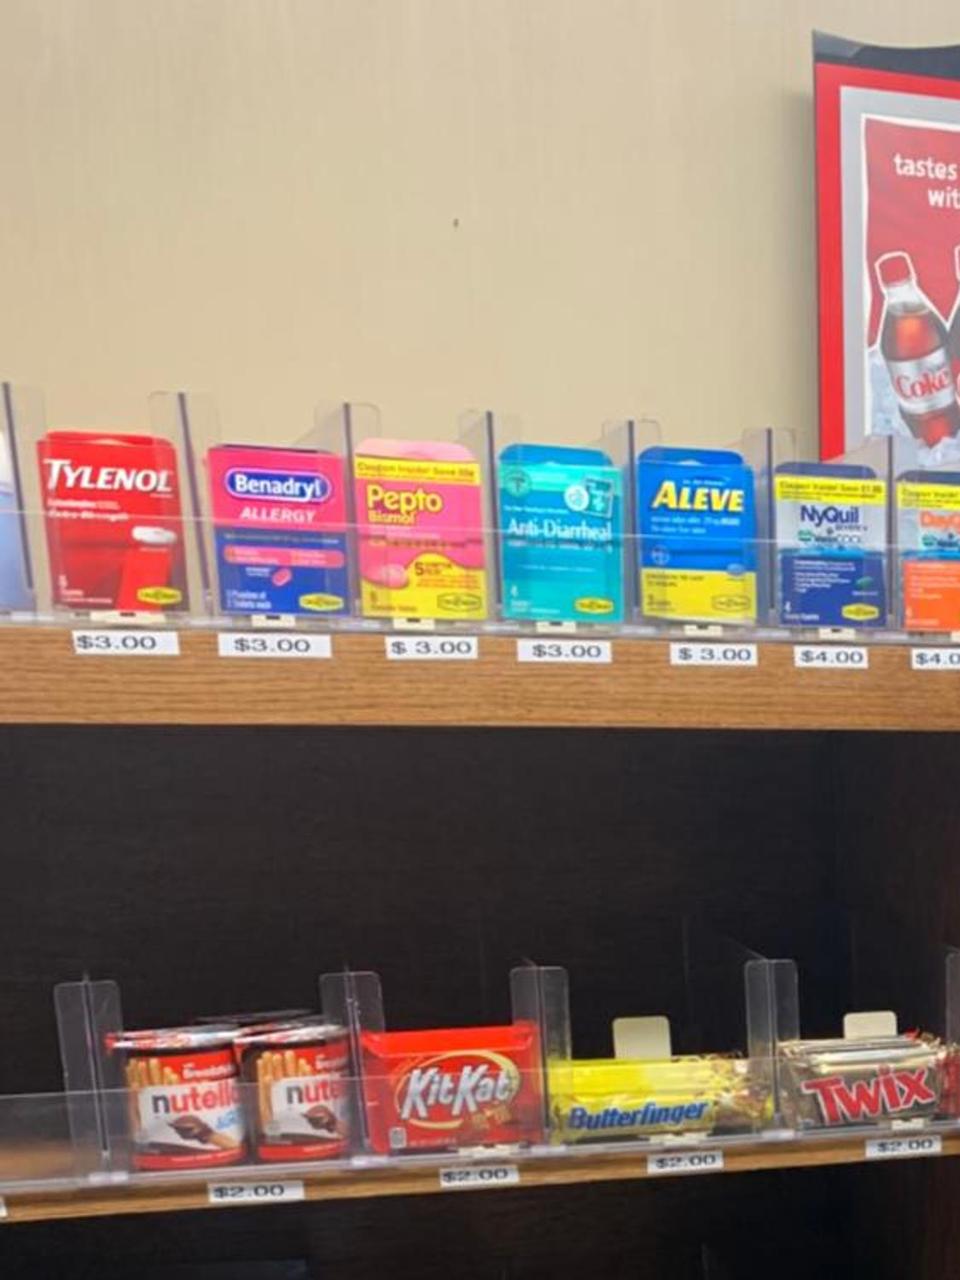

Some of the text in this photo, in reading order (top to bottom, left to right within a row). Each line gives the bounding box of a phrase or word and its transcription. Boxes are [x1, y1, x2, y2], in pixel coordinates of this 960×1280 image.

[894, 153, 957, 182] tastes
[43, 457, 174, 493] TYLENOL
[233, 475, 323, 499] Benadryl
[651, 479, 745, 514] ALEVE
[366, 483, 444, 514] Pepto
[239, 506, 316, 523] ALLERGY
[367, 511, 417, 525] Bismol
[800, 505, 860, 527] NyQuil
[507, 518, 613, 542] Anti-Diarrheal
[76, 634, 158, 651] $3.00
[234, 637, 312, 653] $3.00
[532, 643, 602, 659] $3.00
[801, 650, 864, 664] $4.00
[286, 1076, 345, 1105] nute
[802, 1066, 937, 1126] TWIX
[568, 1101, 708, 1131] Butterfinger
[876, 1138, 934, 1153] $2.00
[655, 1153, 717, 1169] $2.00
[443, 1167, 509, 1184] $2.00
[212, 1183, 285, 1199] $2.00
